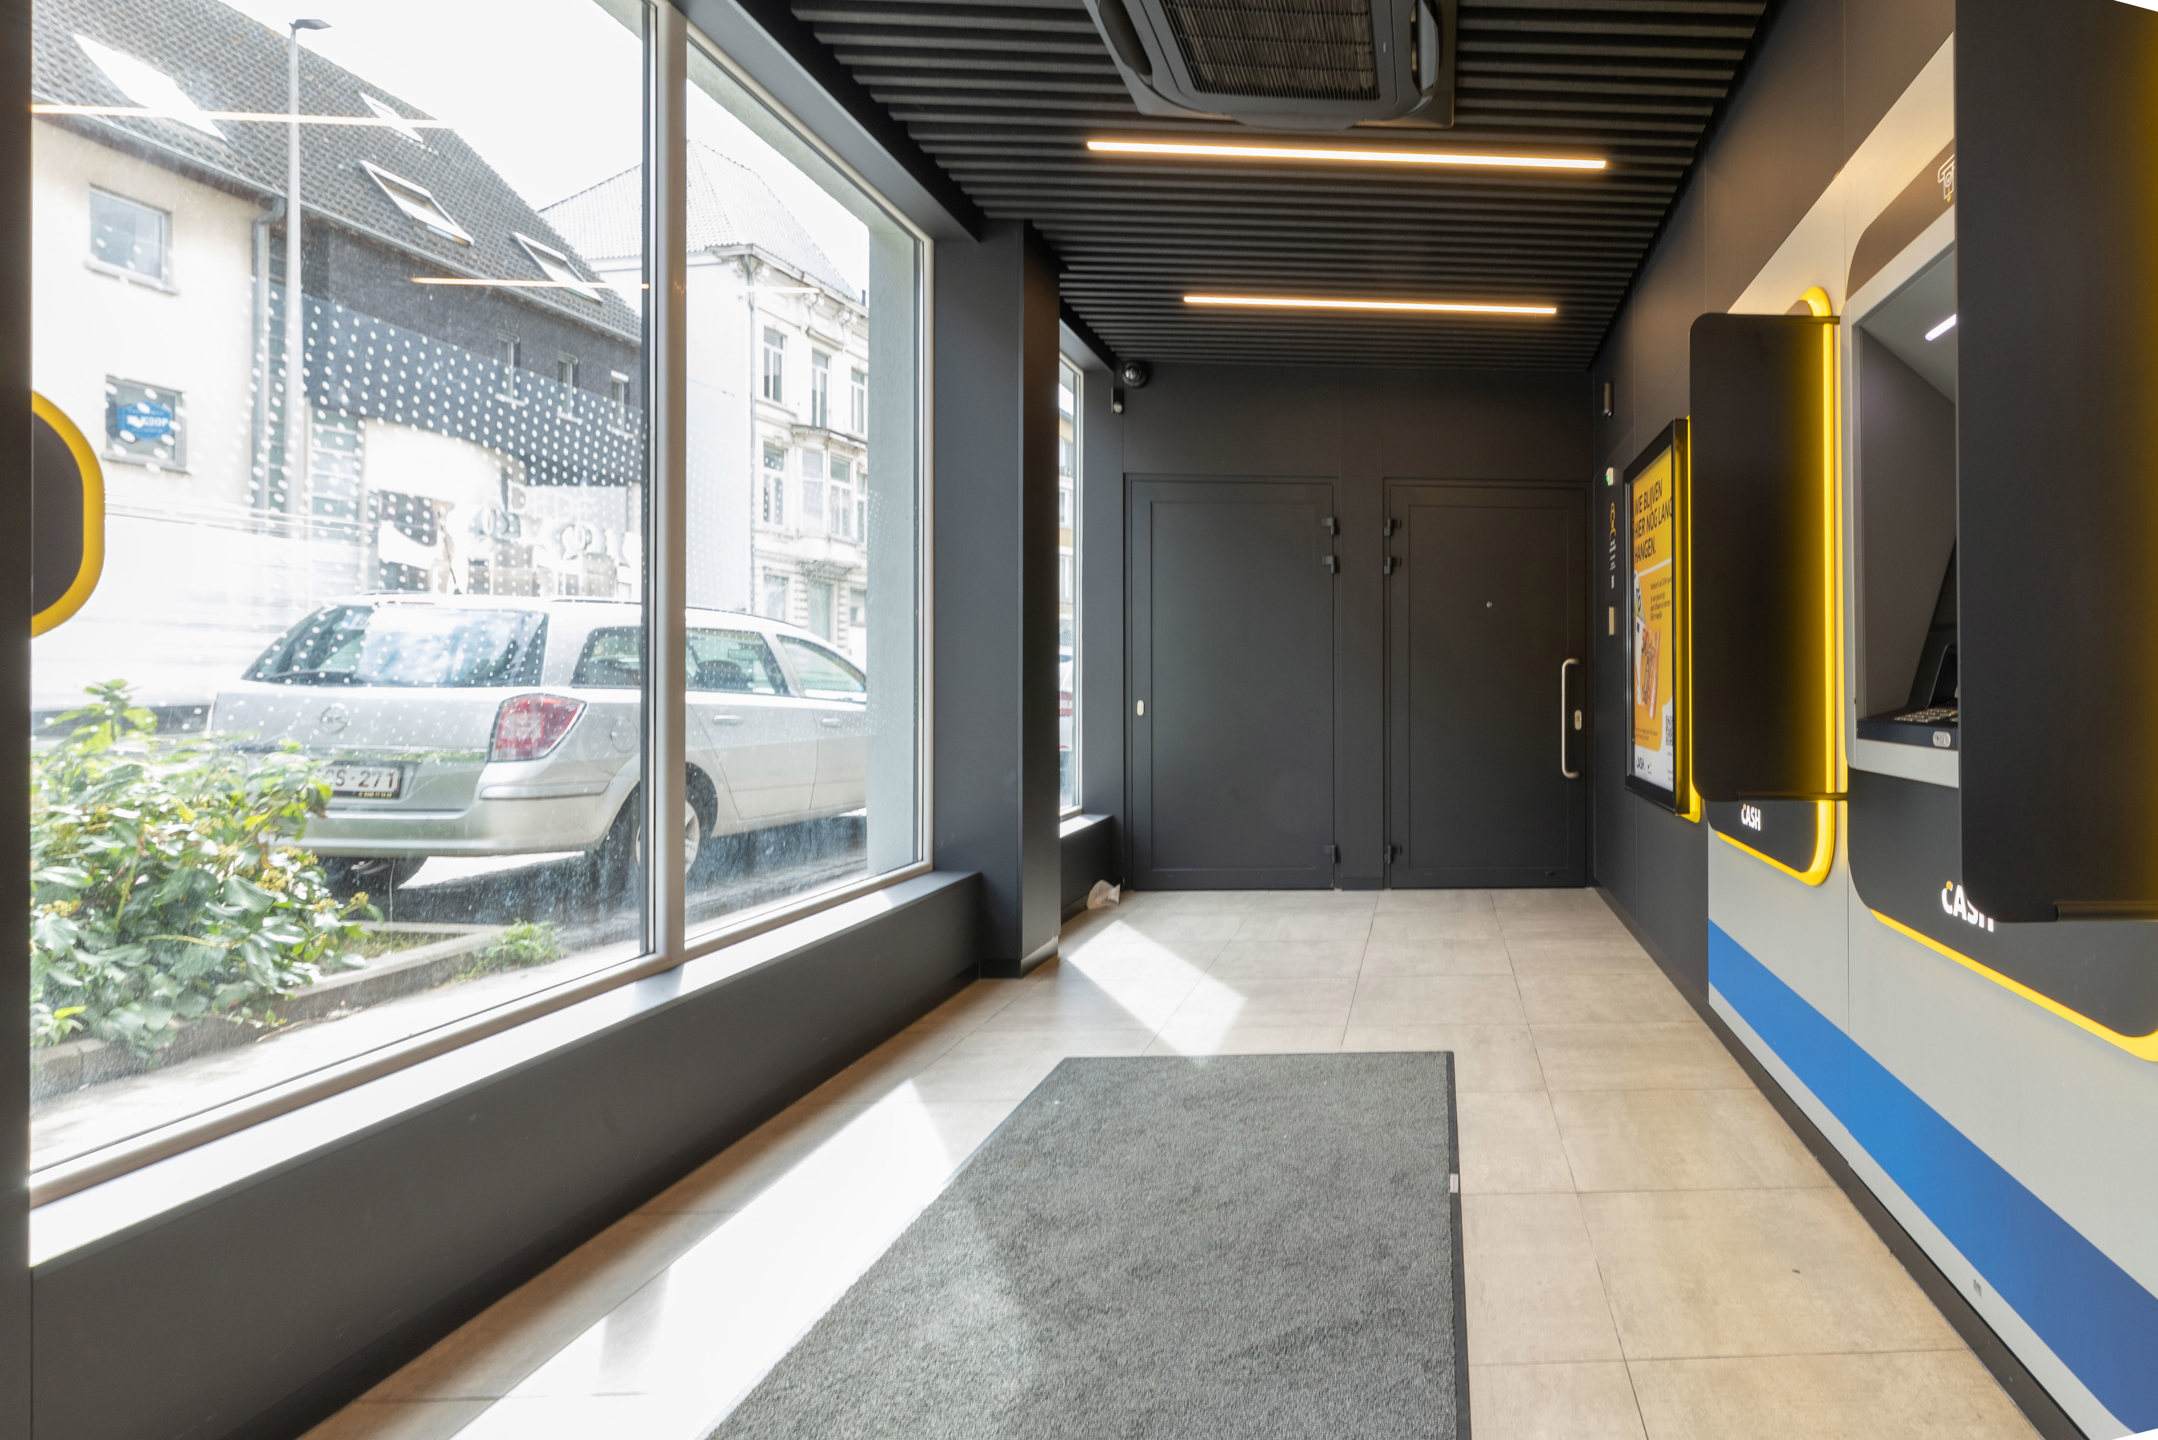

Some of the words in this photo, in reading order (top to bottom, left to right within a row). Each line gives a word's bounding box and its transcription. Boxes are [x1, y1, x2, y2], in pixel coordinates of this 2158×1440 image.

[1644, 478, 1663, 510] BLIJVEN
[1646, 507, 1658, 533] NOG
[317, 766, 395, 788] CS-271
[1741, 803, 1761, 831] CASH
